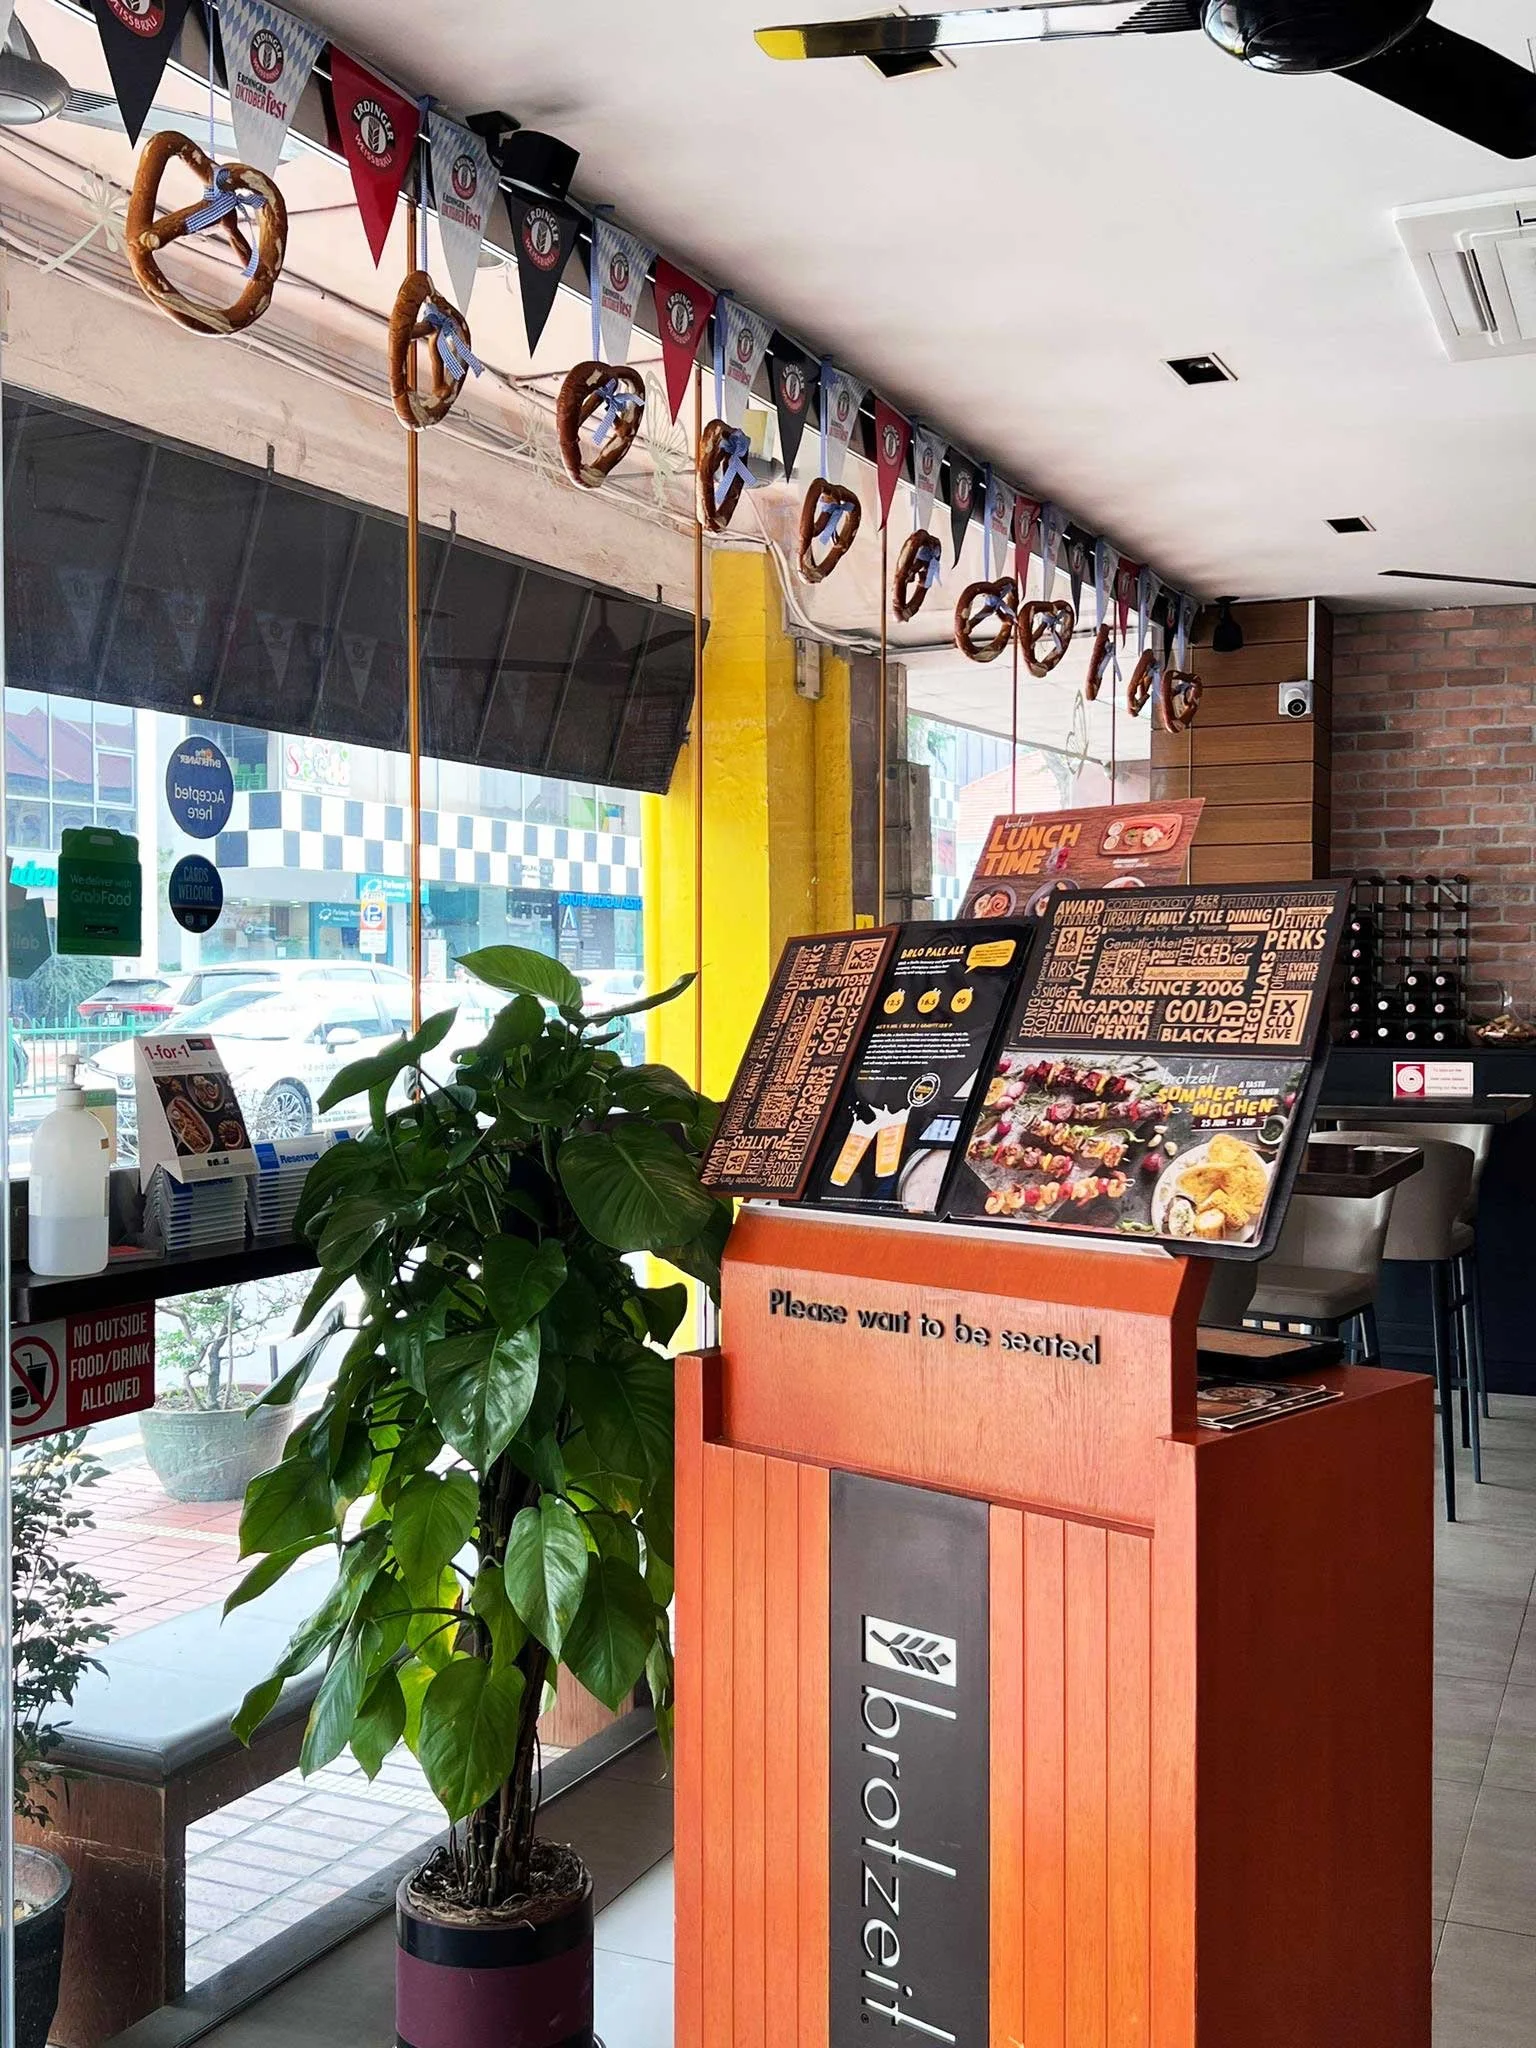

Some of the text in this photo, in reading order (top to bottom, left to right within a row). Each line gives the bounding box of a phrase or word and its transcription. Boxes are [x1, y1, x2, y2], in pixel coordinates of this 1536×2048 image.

[253, 32, 283, 59] ERDINGER
[237, 71, 267, 94] ERDINGER
[353, 99, 394, 142] ERDINGER
[526, 207, 560, 243] ERDINGER
[987, 823, 1082, 852] LUNCH
[983, 850, 1046, 877] TIME
[183, 866, 209, 883] CARDS
[72, 889, 132, 906] GrabFood
[178, 885, 214, 901] WELCOME
[1194, 895, 1220, 904] BEER
[1219, 893, 1335, 908] FRIENDLY SERVICE
[1055, 899, 1106, 914] AWARD
[1105, 897, 1193, 912] contemporary
[1051, 914, 1100, 925] WINNER
[1101, 911, 1138, 925] URBAN
[1142, 908, 1273, 924] FAMILY STYLE DINING
[1061, 930, 1079, 944] SA
[1263, 929, 1328, 949] PERKS
[925, 947, 947, 958] PALE
[948, 945, 966, 956] ALE
[1193, 943, 1221, 956] ICE
[1216, 943, 1255, 964] Bier
[798, 943, 827, 990] PERKS
[1047, 960, 1076, 977] RIBS
[1069, 926, 1102, 1000] PLATTERS
[1222, 968, 1245, 977] Food
[1288, 962, 1319, 971] EVENTS
[811, 973, 873, 988] REGULARS
[1092, 978, 1130, 988] PORK
[1285, 971, 1317, 981] INVITE
[834, 985, 868, 1005] RED
[1040, 983, 1069, 997] sides
[1138, 981, 1246, 996] SINCE 2006
[1239, 951, 1277, 1043] REGULARS
[791, 996, 816, 1025] Bier
[1052, 999, 1156, 1014] SINGAPORE
[1162, 999, 1225, 1023] GOLD
[1268, 999, 1298, 1015] EX
[1018, 998, 1041, 1037] HONG
[1031, 998, 1054, 1037] KONG
[1046, 1013, 1098, 1033] BEIJING
[1095, 1014, 1151, 1025] MANILA
[1215, 1000, 1249, 1043] RED
[1264, 1016, 1295, 1027] CLU
[784, 1023, 800, 1045] ICE
[793, 1038, 819, 1083] SINCE
[812, 994, 836, 1034] 2006
[816, 1006, 849, 1054] GOLD
[835, 1006, 861, 1052] BLACK
[1091, 1024, 1149, 1040] PERTH
[1159, 1027, 1217, 1042] BLACK
[1262, 1028, 1292, 1038] SIVE
[144, 1044, 190, 1060] 1-for-1
[742, 1062, 764, 1098] FAMILY
[758, 1030, 777, 1059] STYLE
[770, 991, 792, 1027] DINING
[1161, 1064, 1220, 1085] brotzeit
[810, 1065, 838, 1114] PERTH
[1158, 1085, 1238, 1103] SOMMER
[776, 1065, 821, 1160] SINGAPORE
[1191, 1098, 1275, 1119] WOCHEN
[727, 1103, 748, 1135] URBAN
[1200, 1119, 1211, 1128] 25
[730, 1134, 785, 1149] PLATTERS
[787, 1114, 816, 1160] BEIJING
[279, 1151, 320, 1165] Reserved
[699, 1138, 728, 1184] AWARD
[744, 1149, 764, 1175] RIBS
[760, 1150, 779, 1175] sides
[766, 1174, 797, 1186] HONG
[73, 1312, 148, 1348] NO OUTSIDE
[769, 1288, 1102, 1365] Please wait to be seated
[70, 1343, 150, 1382] FOOD/DRINK
[81, 1377, 141, 1412] ALLOWED
[861, 1684, 957, 2045] brotzeit
